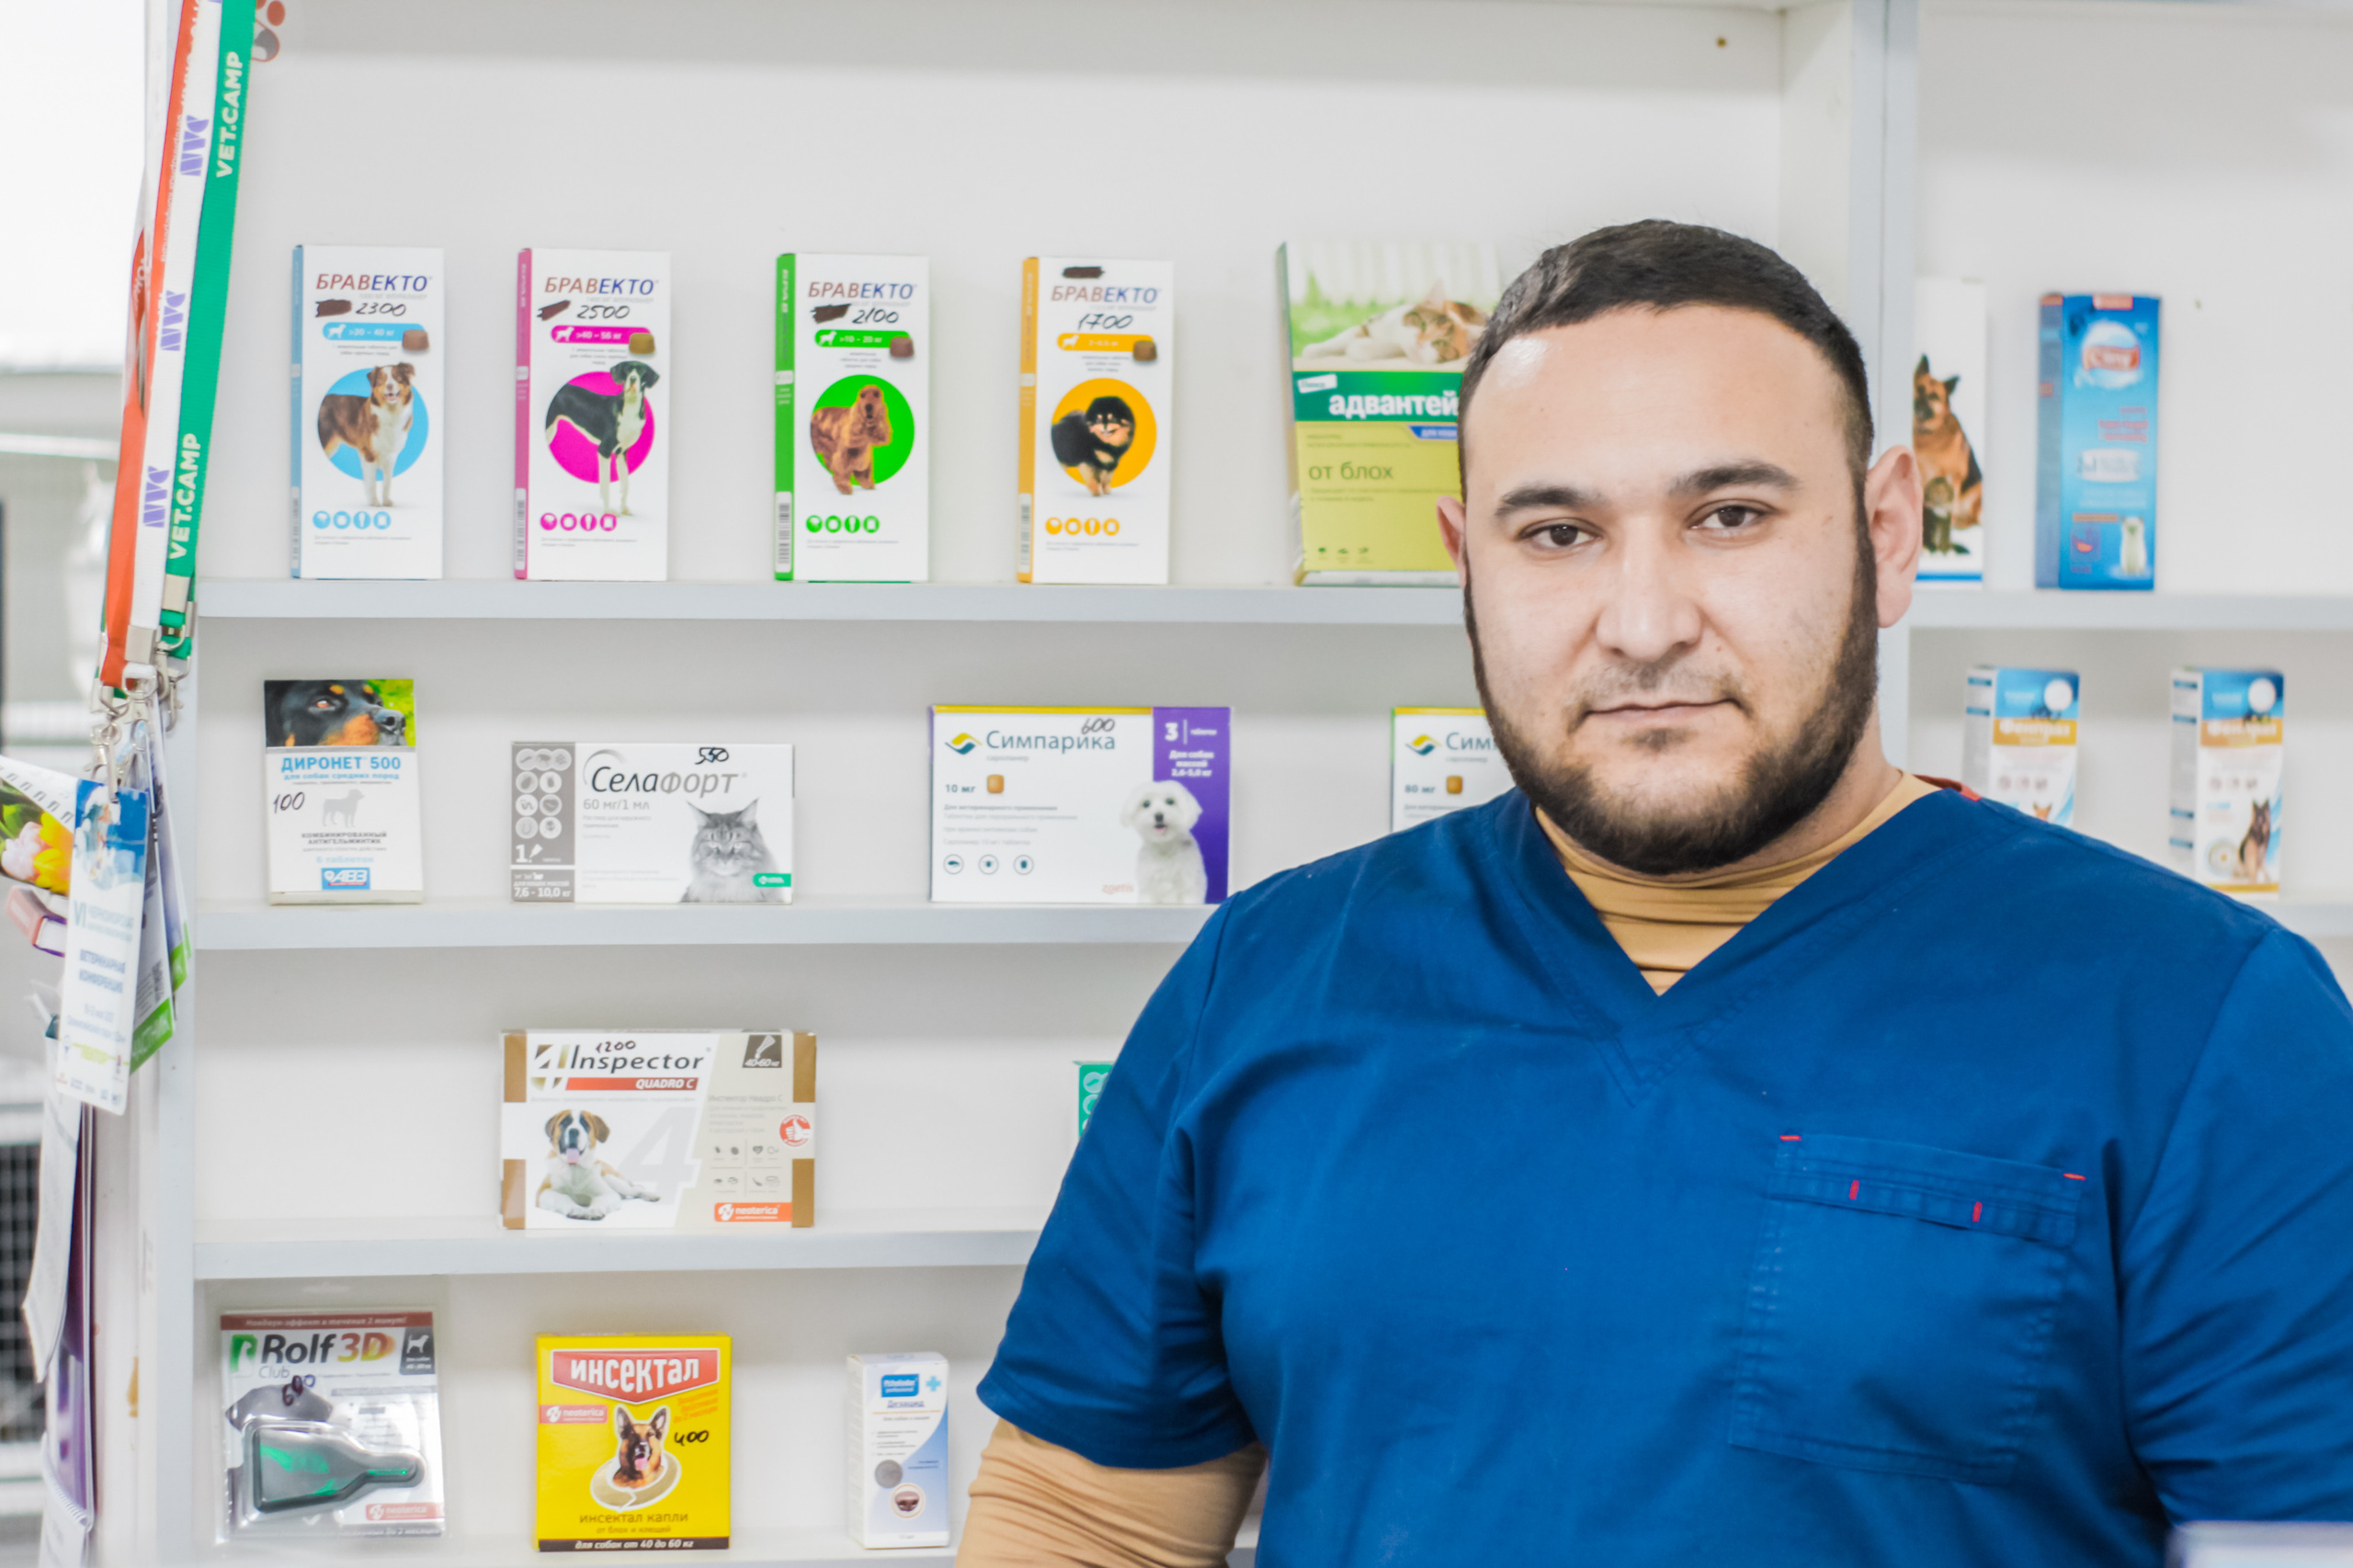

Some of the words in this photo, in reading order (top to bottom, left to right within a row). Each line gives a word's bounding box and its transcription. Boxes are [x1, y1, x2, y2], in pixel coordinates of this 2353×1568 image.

[216, 51, 243, 178] VET.CAMP
[316, 274, 428, 292] БРАВЕКТО
[544, 278, 654, 295] БРАВЕКТО
[808, 281, 915, 300] БРАВЕКТО
[1051, 286, 1158, 303] БРАВЕКТО
[356, 302, 406, 316] 2300
[577, 305, 631, 319] 2500
[851, 308, 899, 324] 2100
[1077, 313, 1133, 331] 1700
[1309, 465, 1333, 480] от
[1340, 461, 1394, 480] блох
[169, 433, 200, 560] VET.CAMP
[1081, 718, 1115, 734] 600
[1165, 722, 1178, 741] 3
[986, 730, 1115, 755] Симпарика
[281, 756, 362, 772] ДИРОНЕТ
[370, 756, 401, 769] 500
[591, 766, 739, 798] Селафорт
[946, 785, 958, 793] 10
[1404, 784, 1418, 793] 80
[273, 791, 305, 813] 100
[583, 799, 600, 810] 60
[603, 799, 630, 810] мг/1
[633, 801, 650, 810] мл
[571, 1044, 704, 1074] Inspector
[635, 1078, 684, 1090] QUADRO
[261, 1334, 336, 1364] Rolf
[337, 1332, 395, 1362] 3D
[258, 1366, 290, 1379] Club
[579, 1513, 642, 1523] инсектал
[647, 1512, 688, 1523] капли
[641, 1540, 654, 1549] 40
[668, 1539, 682, 1549] 60
